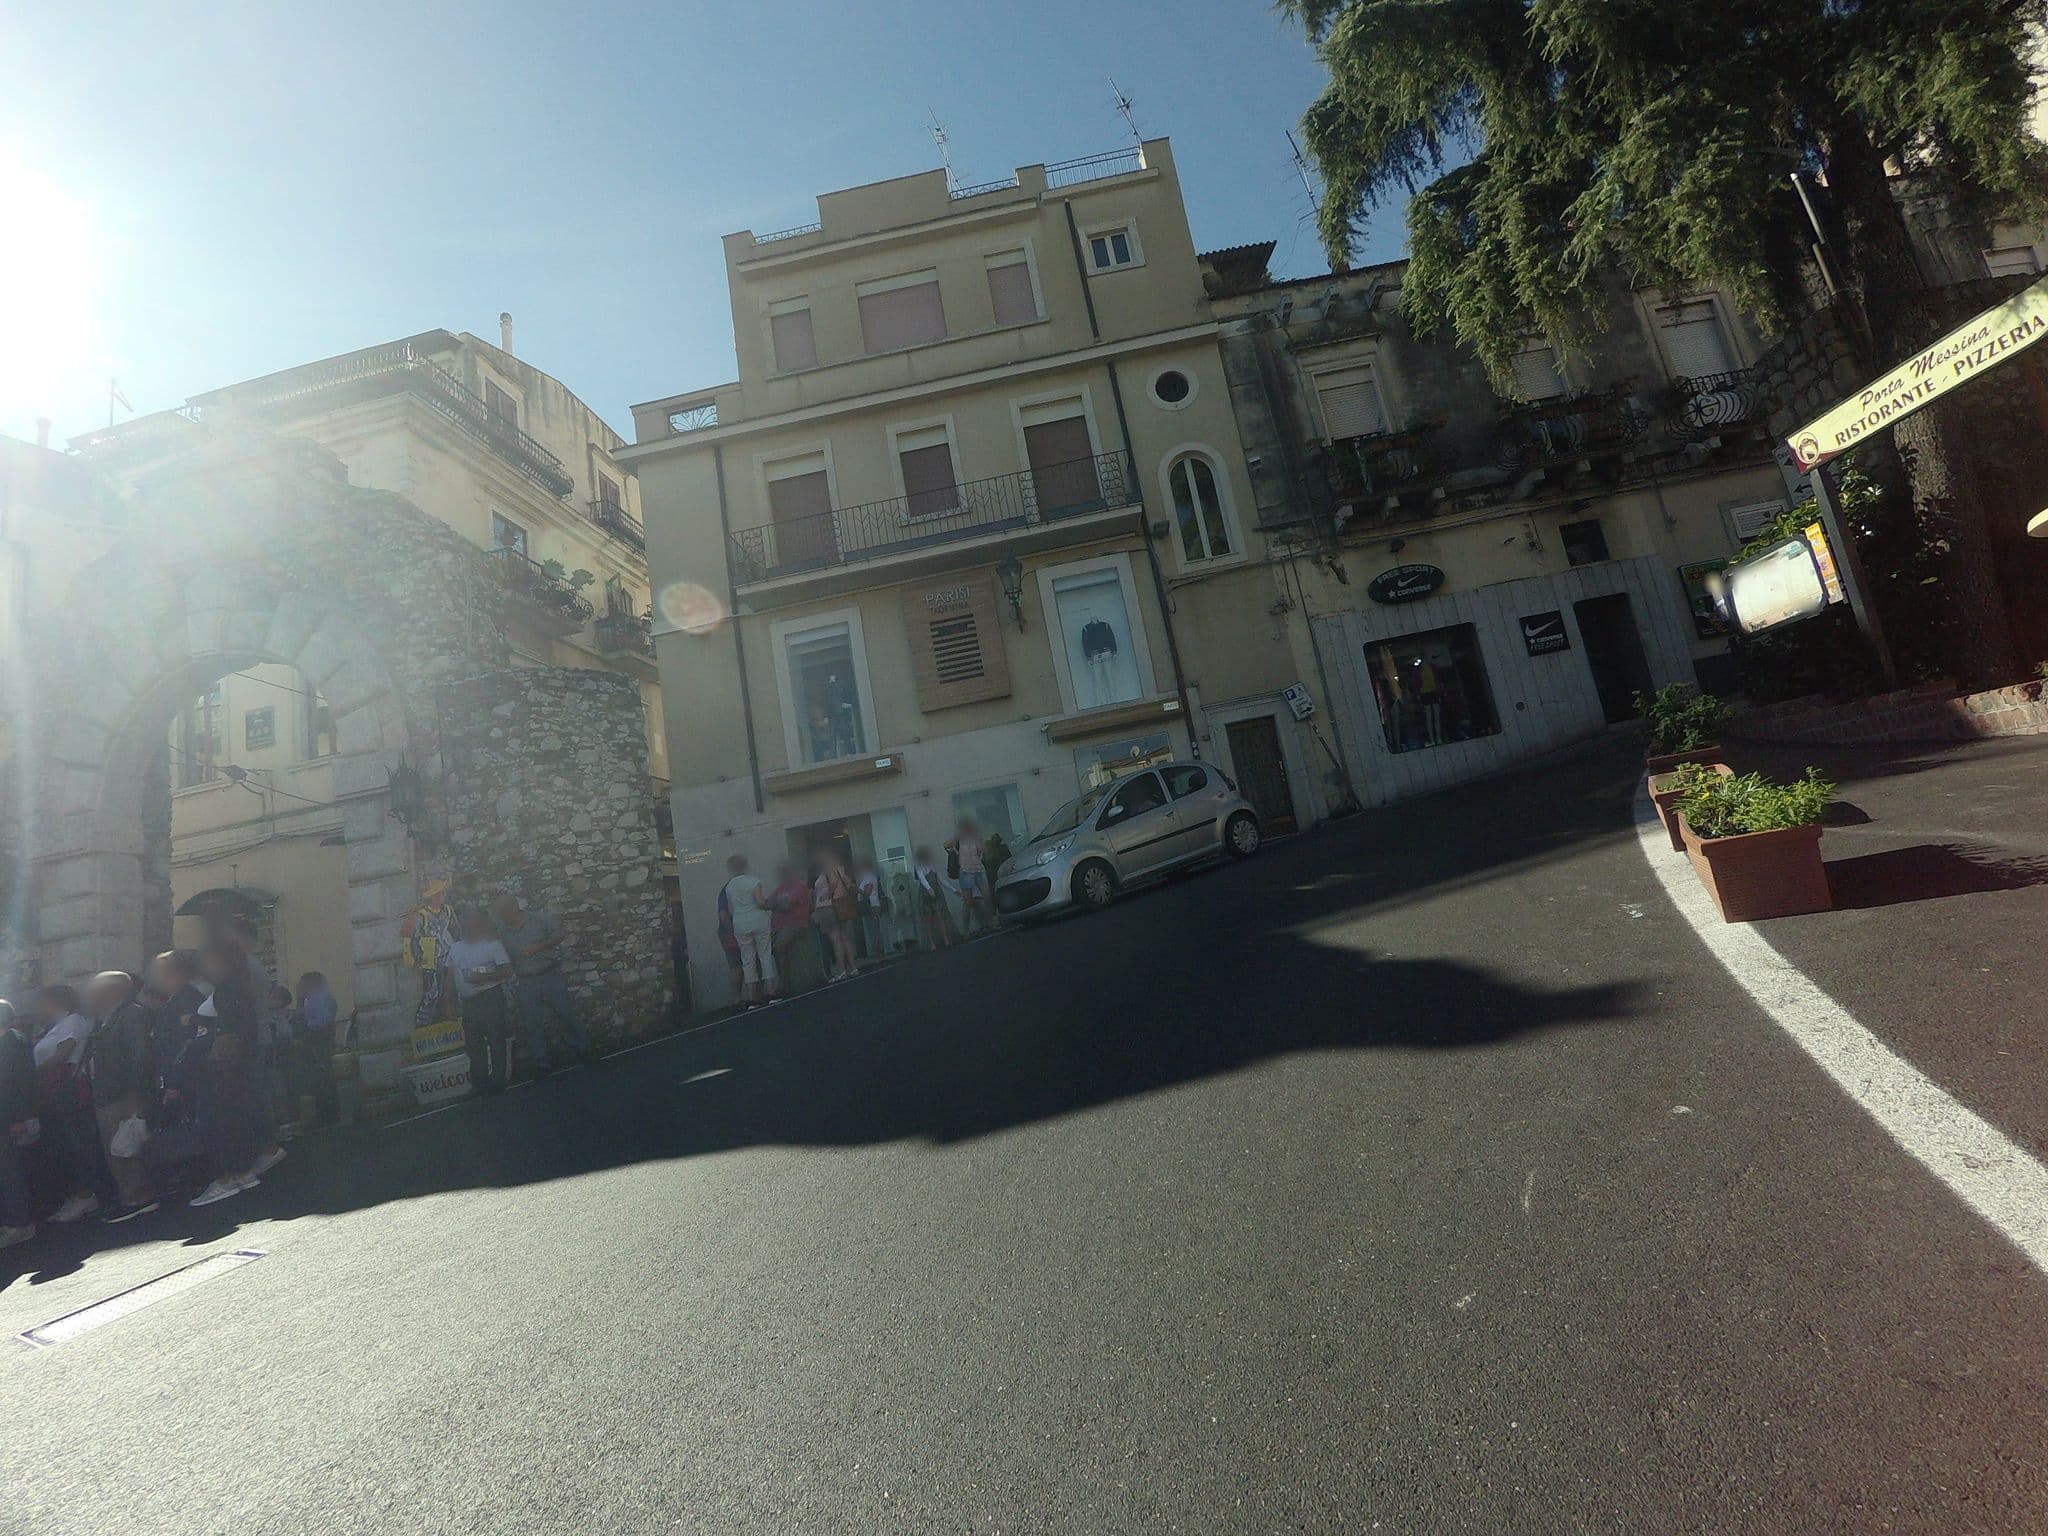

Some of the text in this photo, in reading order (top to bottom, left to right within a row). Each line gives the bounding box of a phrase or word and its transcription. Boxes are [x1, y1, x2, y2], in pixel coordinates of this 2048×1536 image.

[1860, 325, 1991, 412] Porta Messina
[1834, 377, 1937, 446] RISTORANTE
[1953, 314, 2046, 377] PIZZERIA
[1376, 565, 1435, 584] FREE SPORT
[925, 586, 970, 605] PARISI
[1397, 583, 1432, 597] CONVERSE
